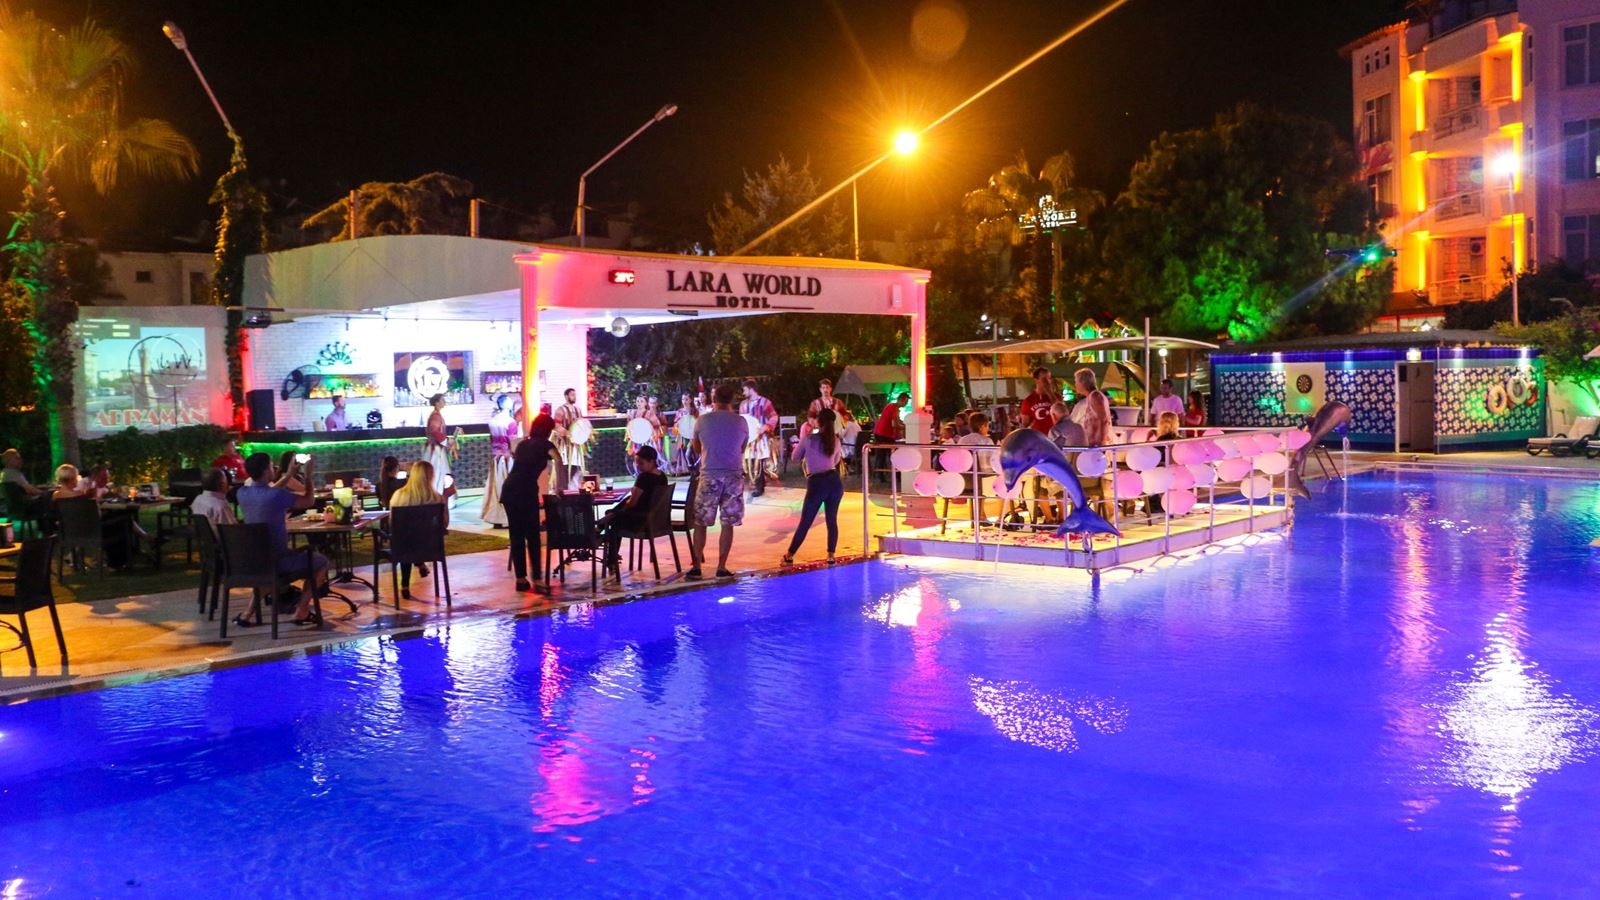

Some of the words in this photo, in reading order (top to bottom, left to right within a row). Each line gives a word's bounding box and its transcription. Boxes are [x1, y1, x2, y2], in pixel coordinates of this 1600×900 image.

[666, 270, 732, 293] LARA
[743, 273, 822, 297] WORLD
[716, 296, 771, 308] HOTEL
